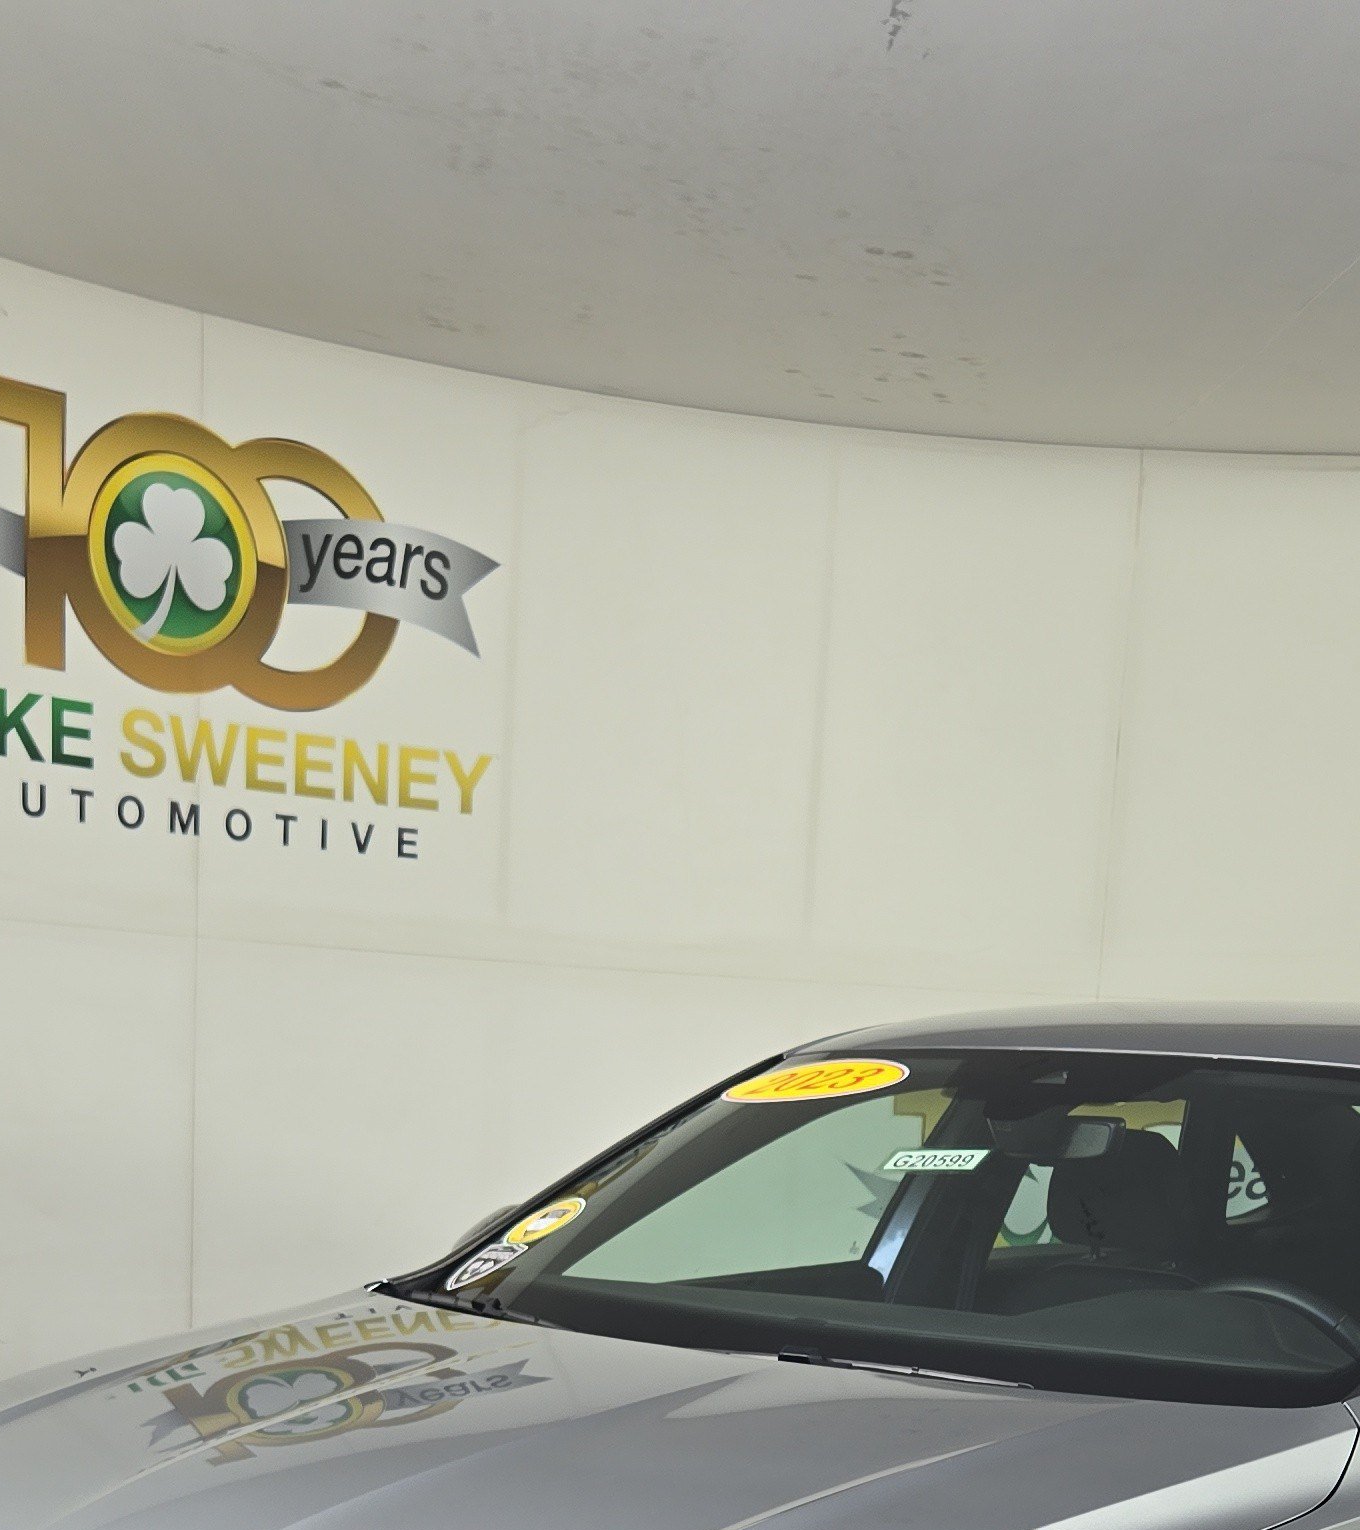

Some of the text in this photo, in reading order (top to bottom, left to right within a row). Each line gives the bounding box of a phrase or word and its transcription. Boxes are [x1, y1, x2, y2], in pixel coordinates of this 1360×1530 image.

[298, 532, 451, 600] years
[120, 708, 492, 815] SWEENEY
[744, 1068, 886, 1094] 2023
[893, 1154, 975, 1167] G20599
